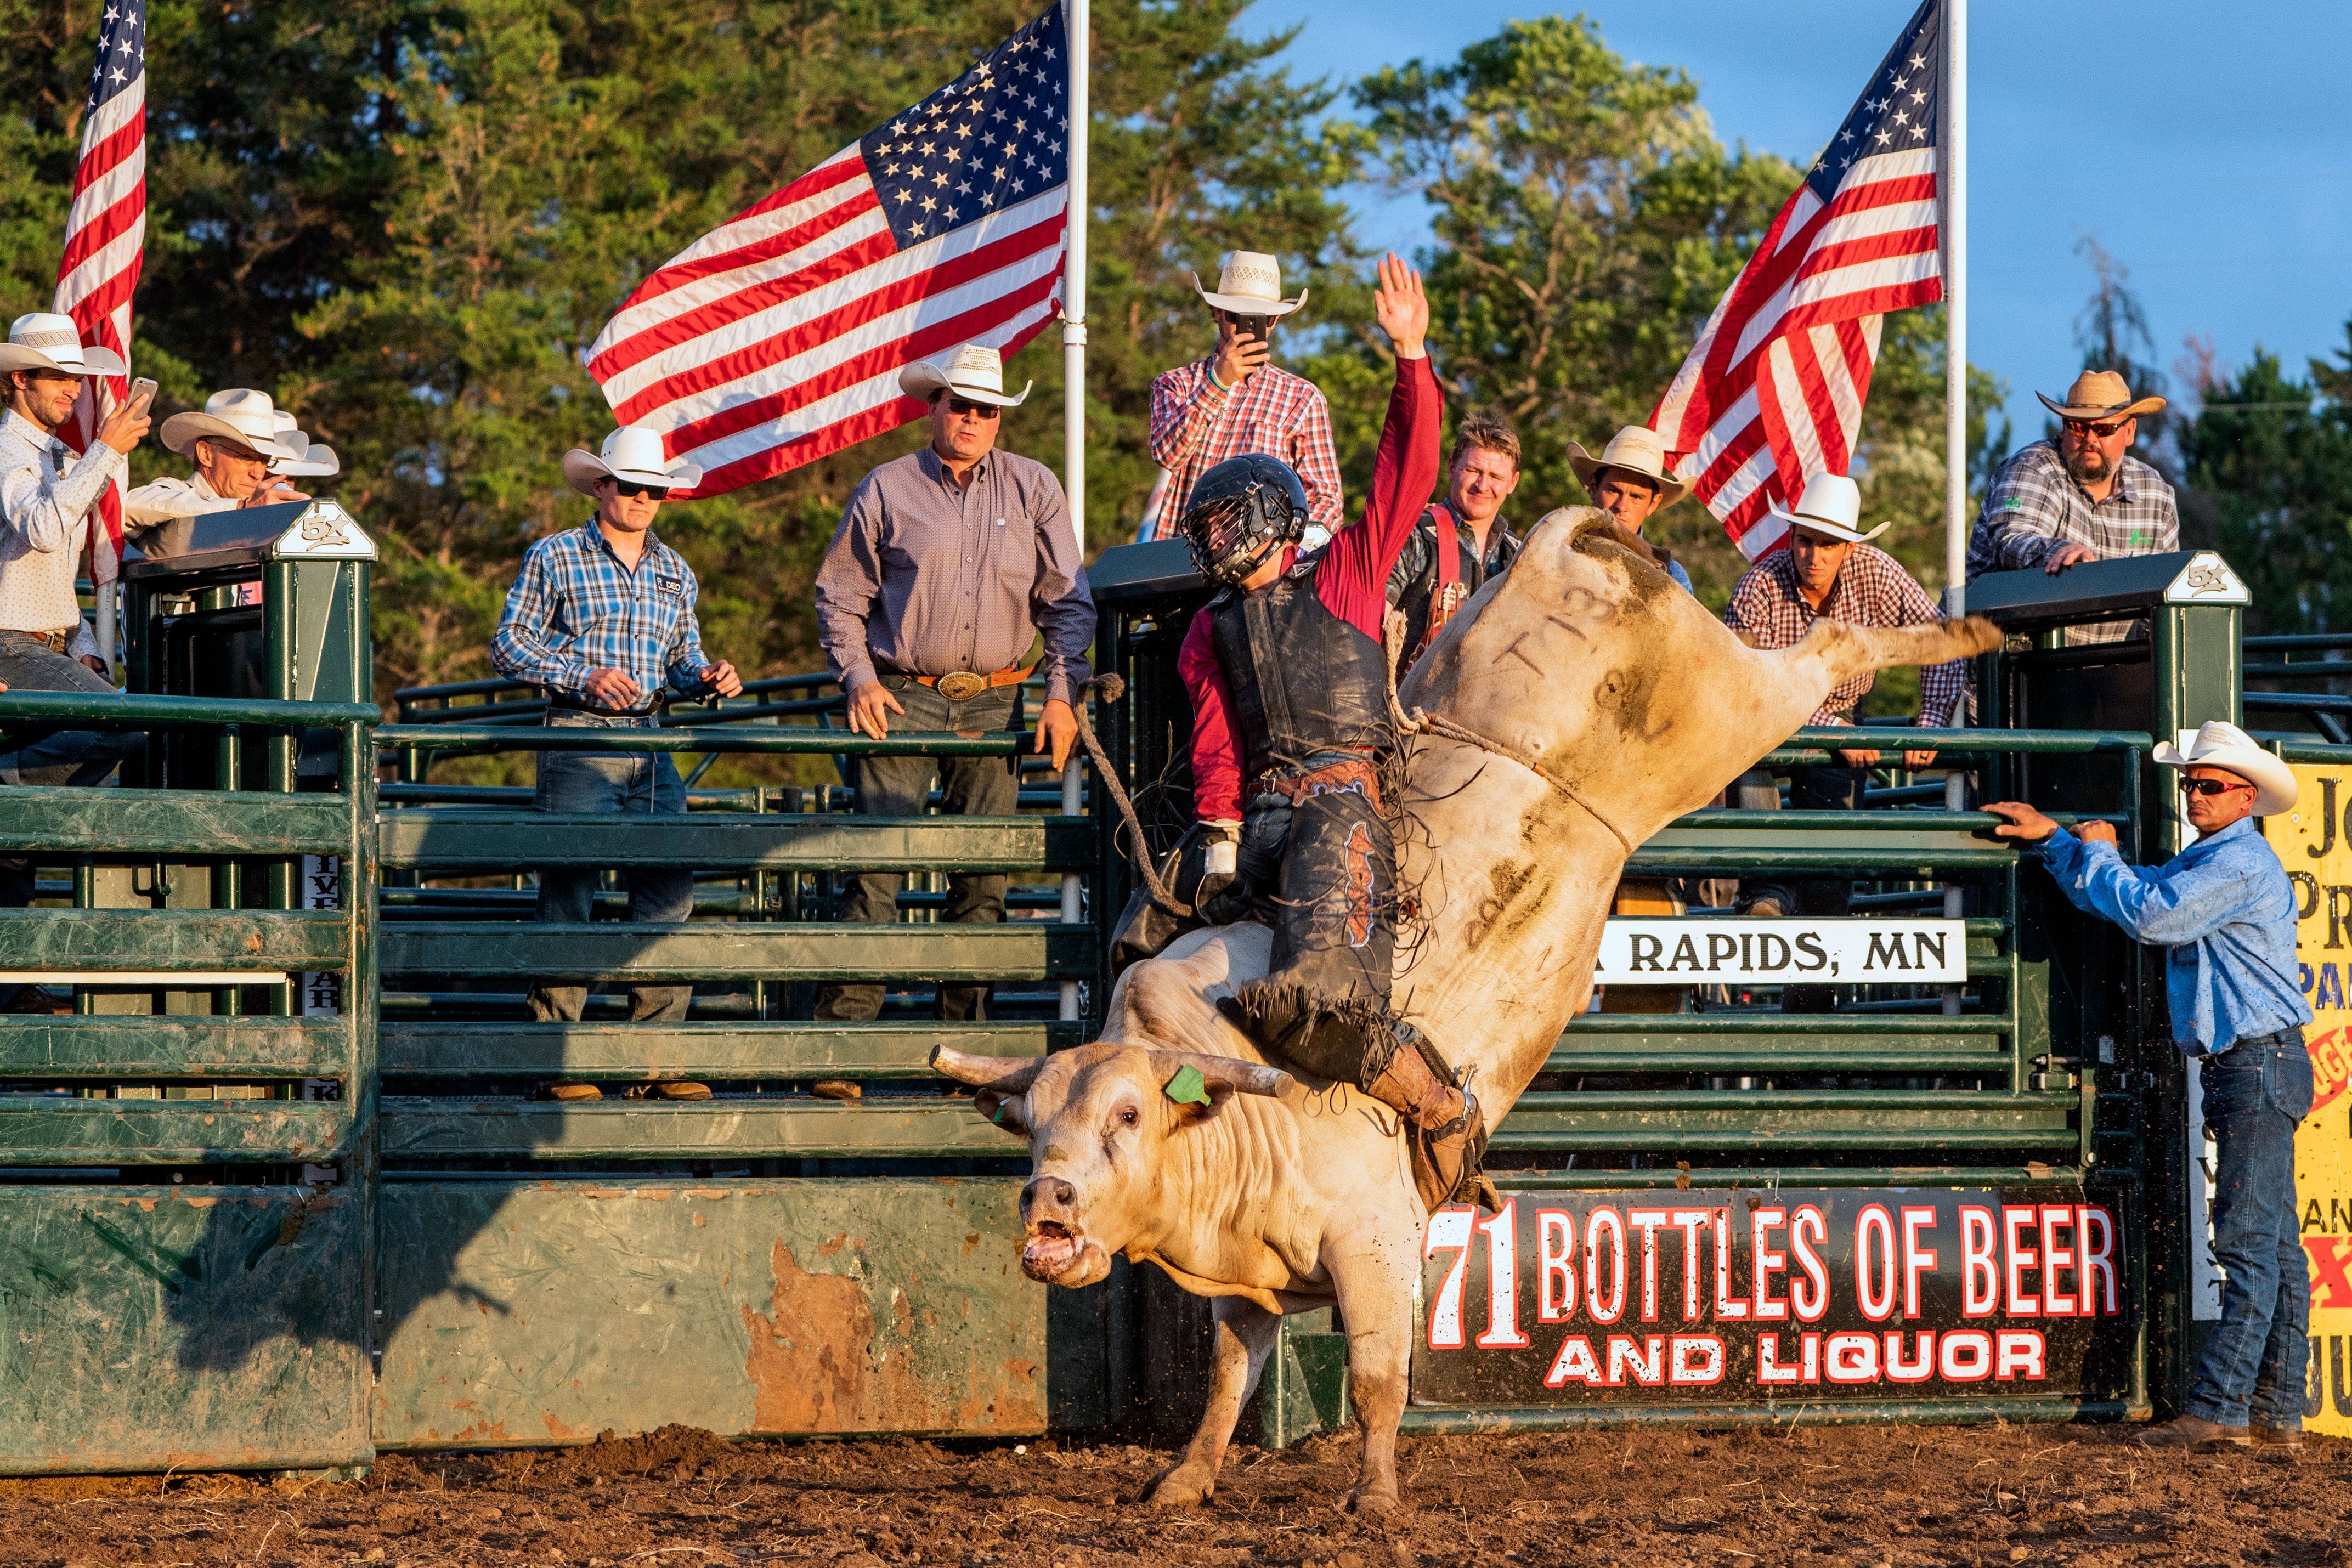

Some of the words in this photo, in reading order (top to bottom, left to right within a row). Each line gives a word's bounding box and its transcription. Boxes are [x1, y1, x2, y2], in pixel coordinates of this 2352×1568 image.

[1629, 931, 1839, 977] RAPIDS,
[1863, 932, 1947, 970] MN
[1422, 1197, 1530, 1350] 71
[1536, 1203, 1830, 1325] BOTTLES
[1855, 1203, 1938, 1322] OF
[1959, 1204, 2120, 1318] BEER
[1543, 1333, 1727, 1388] AND
[1757, 1329, 2046, 1385] LIQUOR
